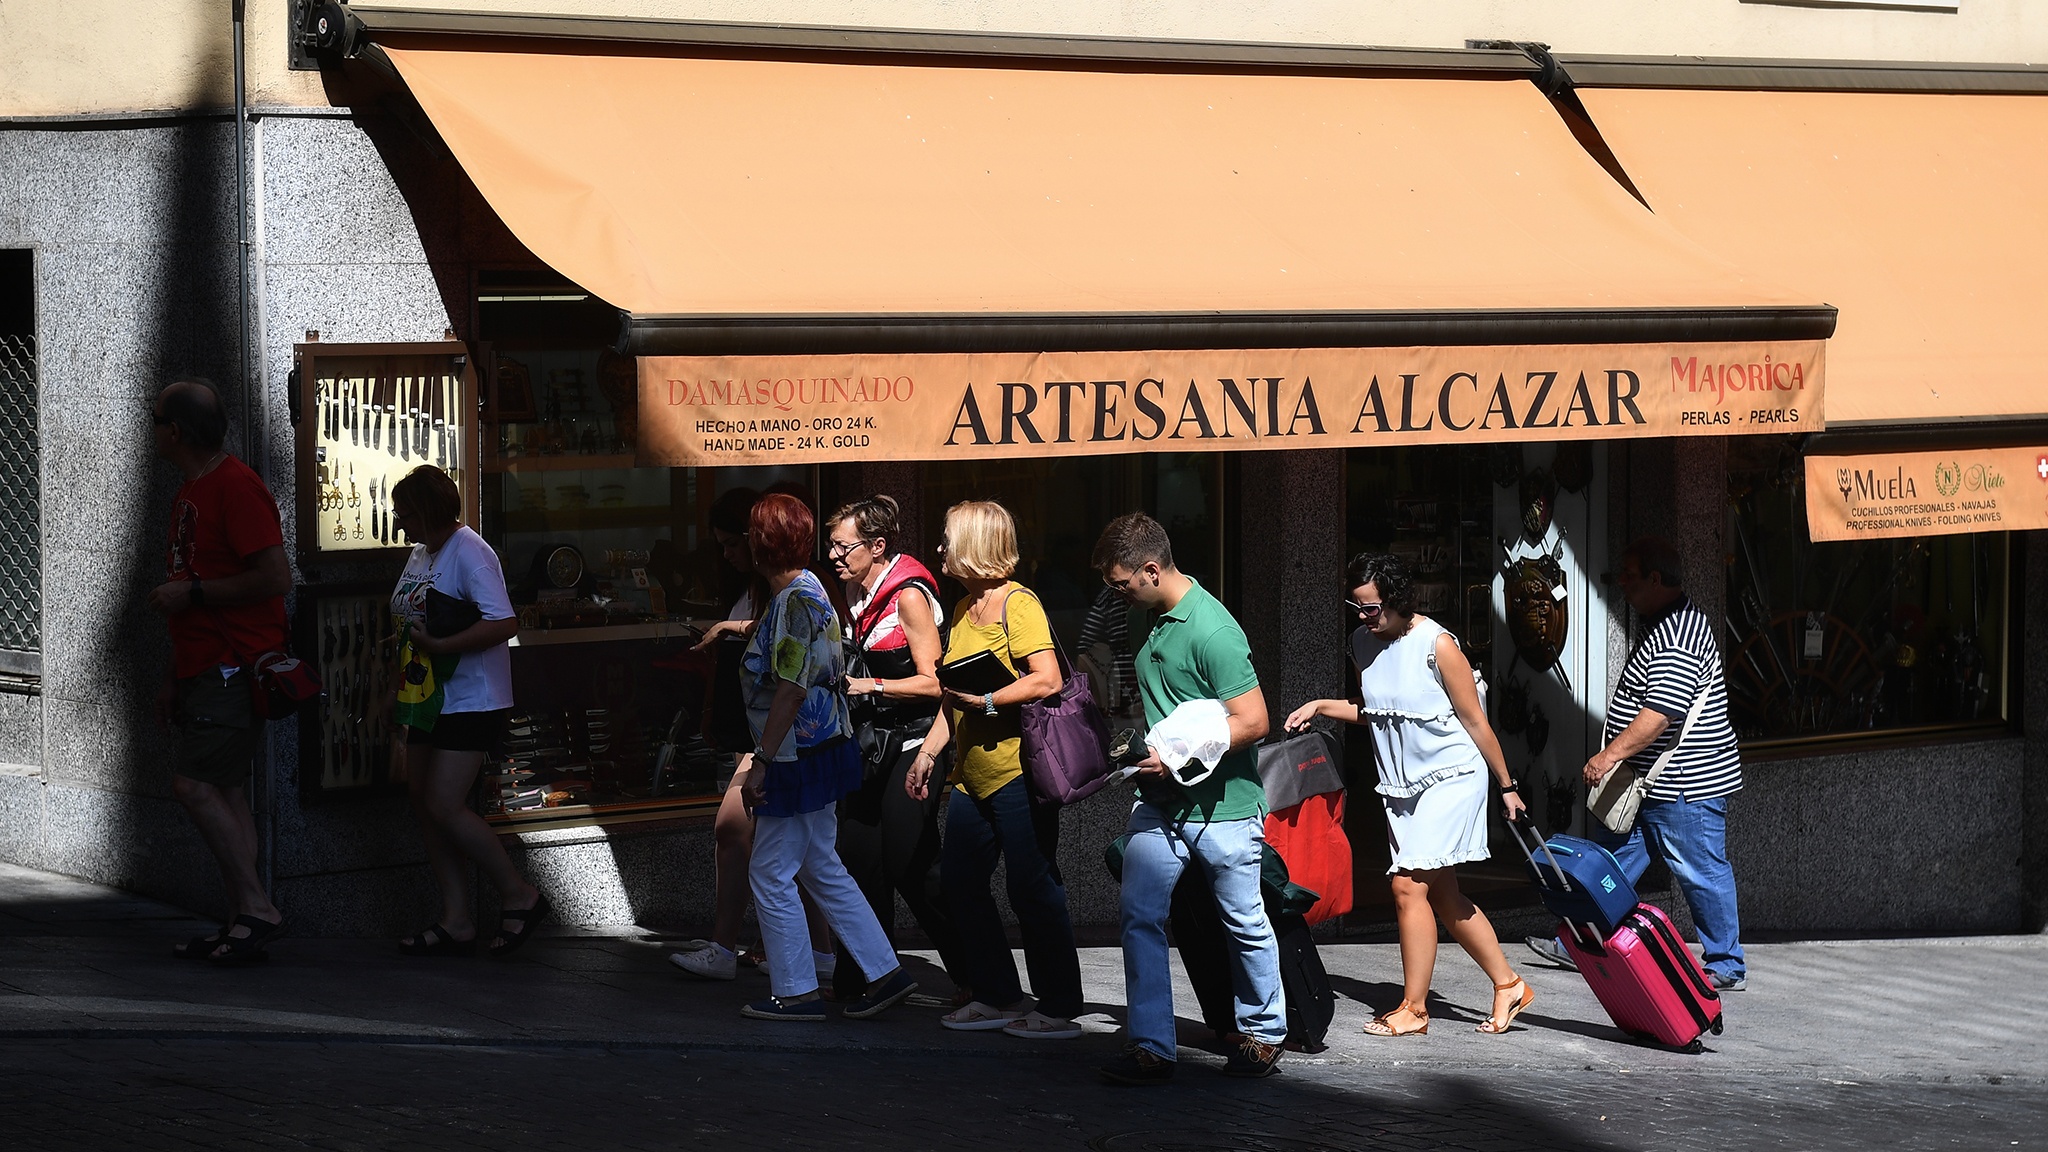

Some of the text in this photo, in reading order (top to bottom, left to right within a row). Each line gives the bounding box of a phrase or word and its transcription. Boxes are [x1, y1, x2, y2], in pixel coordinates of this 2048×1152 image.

[667, 377, 915, 411] DAMASQUINADO
[943, 369, 1648, 446] ARTESANIA ALCAZAR
[1681, 411, 1731, 426] PERLAS
[1749, 408, 1799, 423] PEARLS
[696, 420, 746, 434] HECHO
[748, 420, 758, 433] A
[761, 418, 801, 432] MANO
[812, 418, 843, 431] ORO
[846, 417, 861, 430] 24
[864, 417, 878, 429] K.
[704, 438, 745, 452] HAND
[748, 437, 786, 451] MADE
[797, 436, 812, 450] 24
[815, 436, 830, 449] K.
[832, 434, 870, 448] GOLD
[1851, 505, 1893, 518] CUCHILLOS
[1894, 502, 1955, 515] PROFESIONALES
[1961, 499, 1996, 510] NAVAJAS
[1846, 518, 1904, 531] PROFESSIONAL
[1905, 516, 1932, 527] KNIVES
[1938, 513, 1972, 525] FOLDING
[1974, 511, 2001, 523] KNIVES
